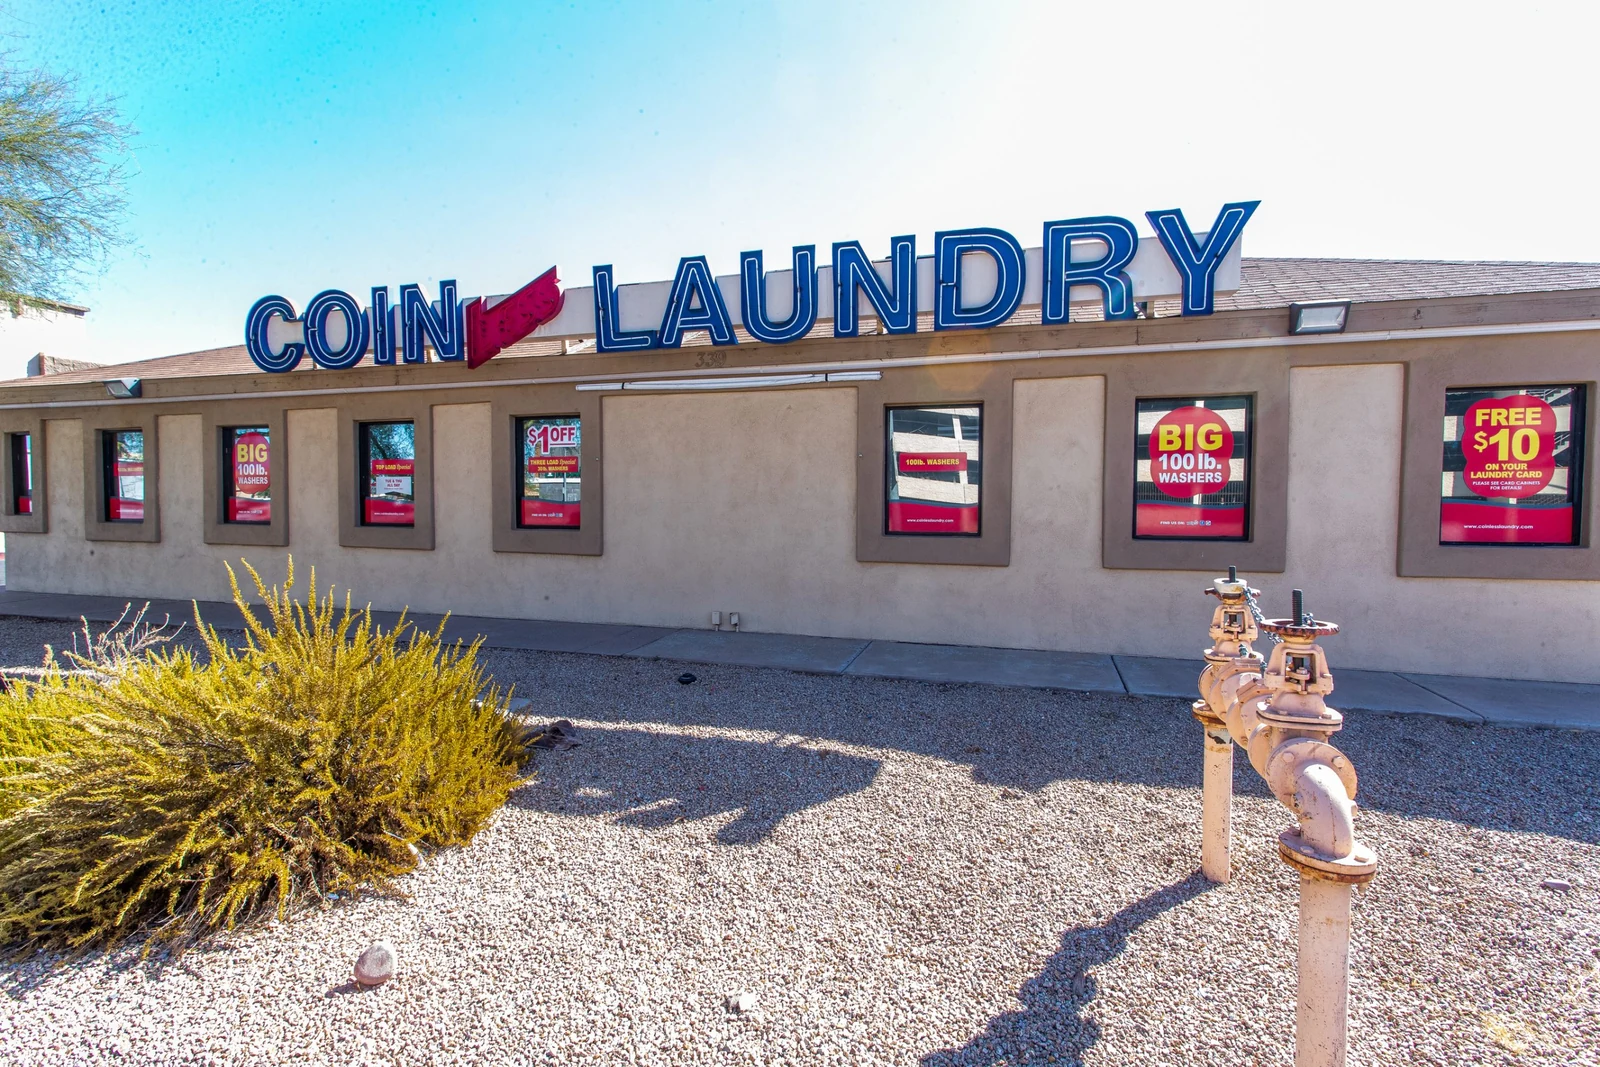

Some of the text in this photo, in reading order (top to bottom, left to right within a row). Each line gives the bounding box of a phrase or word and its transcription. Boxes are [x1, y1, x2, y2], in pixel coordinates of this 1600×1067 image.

[245, 279, 465, 373] COIN
[592, 200, 1261, 353] LAUNDRY
[1475, 407, 1542, 427] FREE
[550, 427, 576, 443] OFF
[1158, 423, 1223, 451] BIG
[1473, 427, 1540, 462] $10
[237, 443, 268, 463] BIG
[238, 464, 268, 475] 100 lb.
[1158, 453, 1222, 470] 100 lb.
[1485, 463, 1528, 471] ON YOUR
[238, 476, 268, 485] WASHERS
[1159, 472, 1223, 483] WASHERS
[1470, 470, 1543, 479] LAUNDRY CARD
